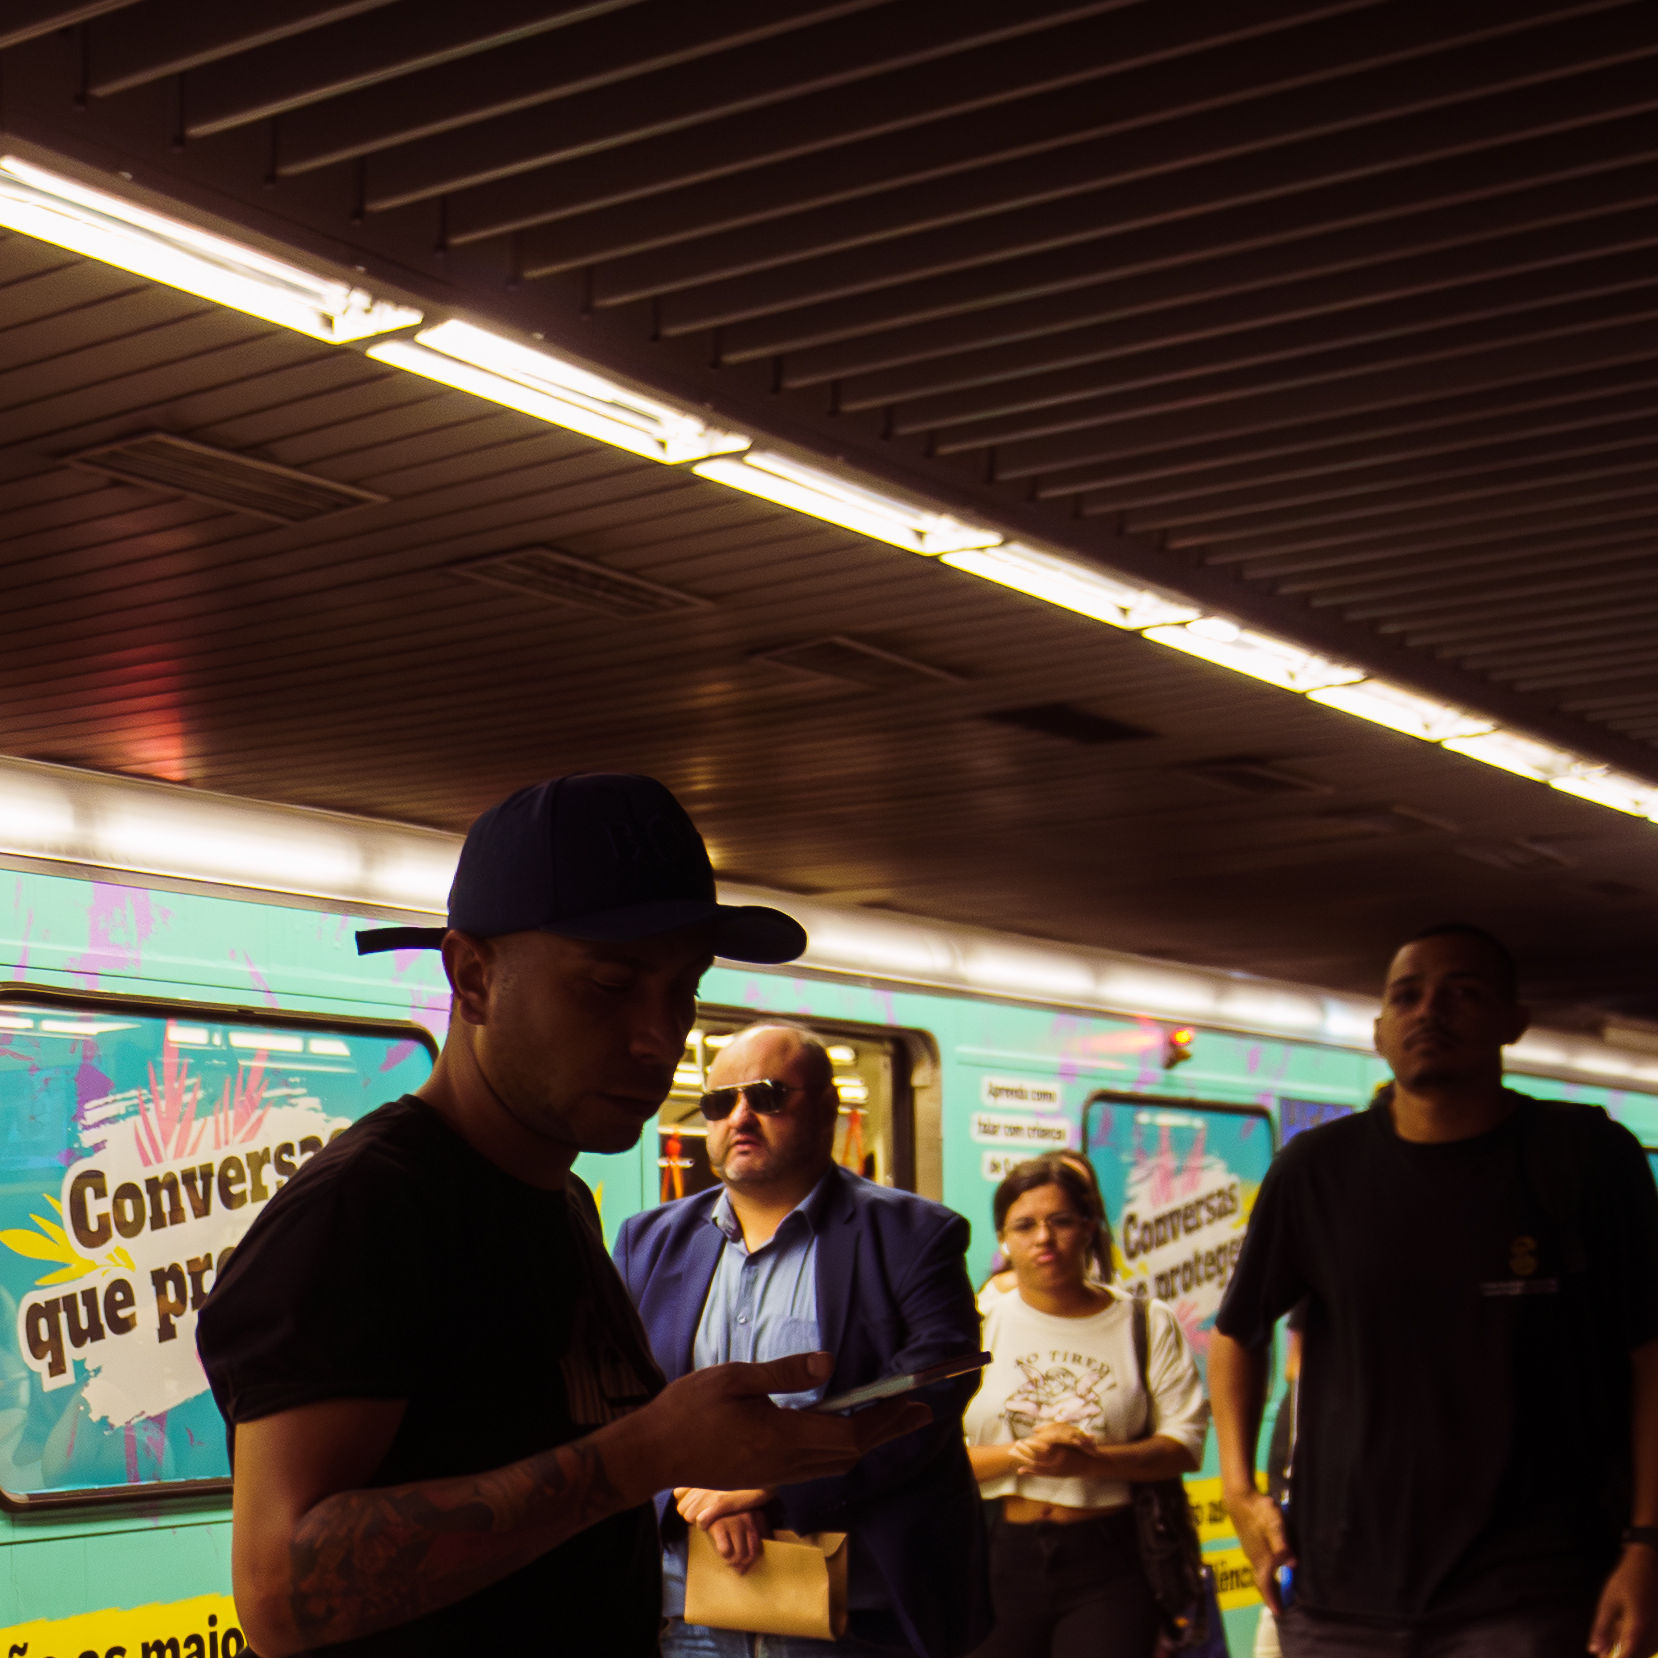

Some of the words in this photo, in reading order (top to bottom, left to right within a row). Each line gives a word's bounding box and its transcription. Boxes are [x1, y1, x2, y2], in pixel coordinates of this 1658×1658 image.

[70, 1128, 347, 1249] Convers
[1124, 1182, 1237, 1259] Conversas
[25, 1278, 137, 1377] que
[150, 1246, 236, 1344] pr
[1155, 1238, 1242, 1300] protege
